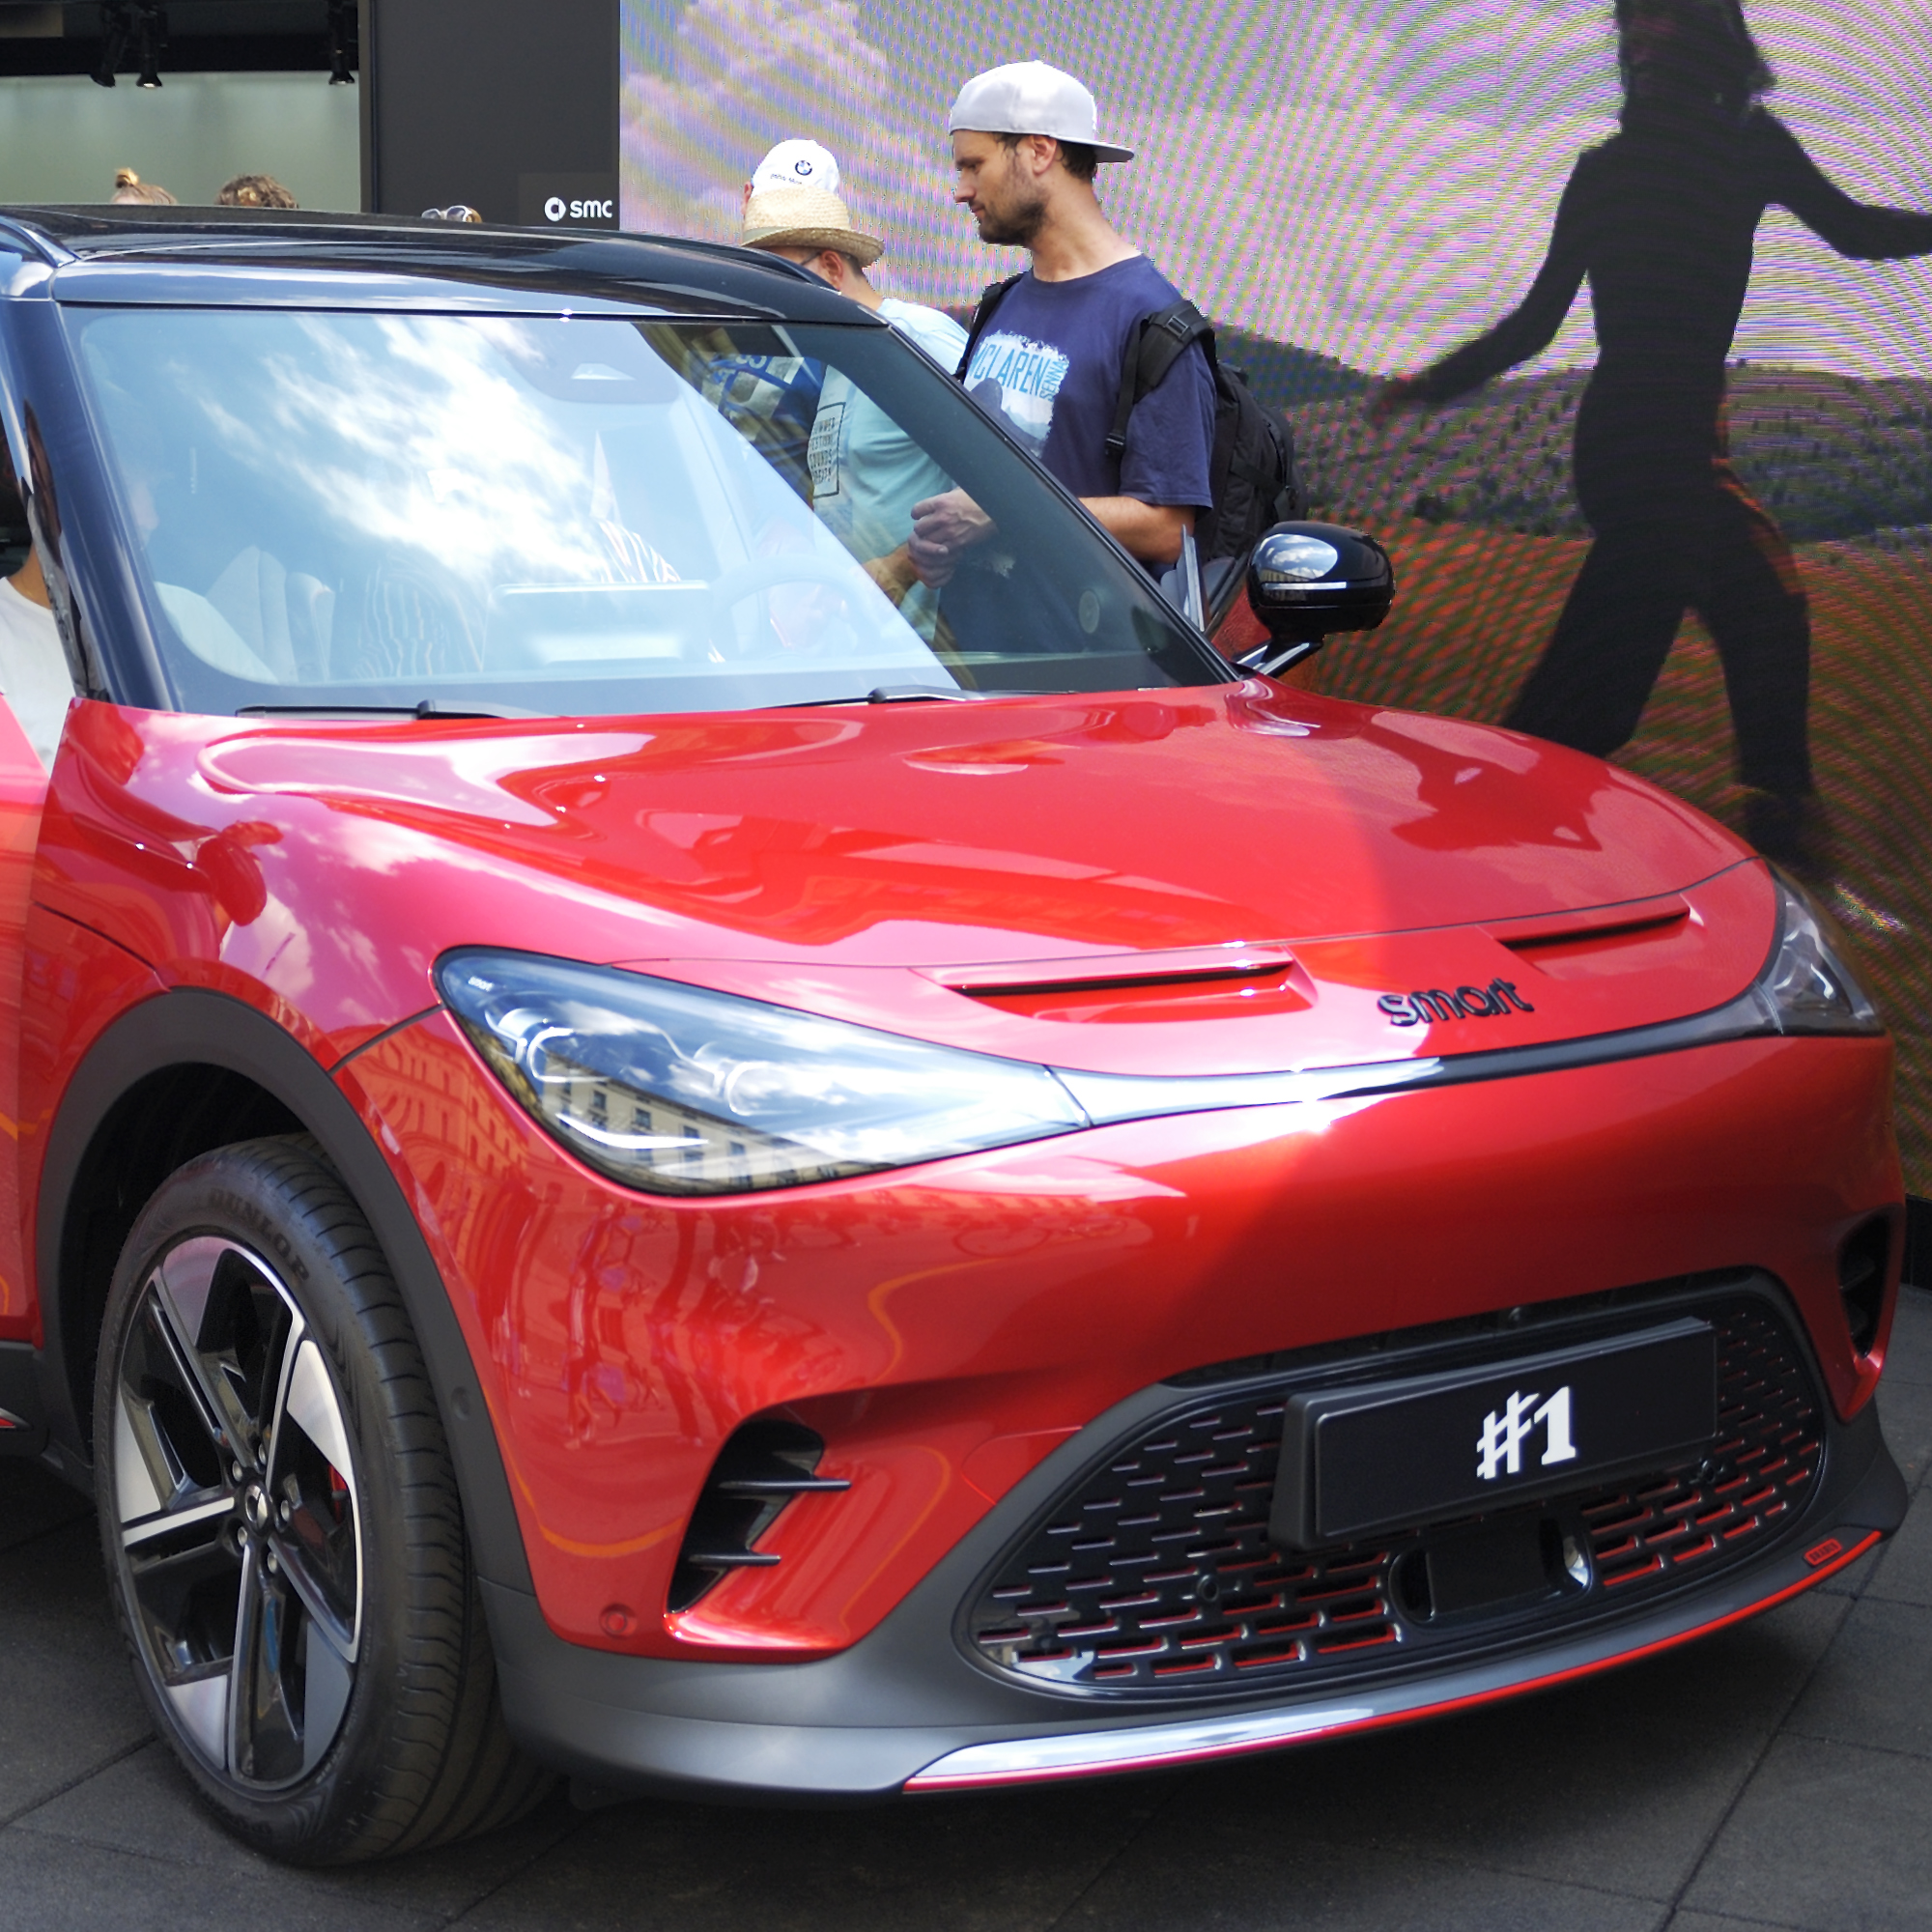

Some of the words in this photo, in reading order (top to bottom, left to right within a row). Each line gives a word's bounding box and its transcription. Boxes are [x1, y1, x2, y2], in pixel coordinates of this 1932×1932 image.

[1038, 360, 1065, 403] SENNA
[1377, 977, 1535, 1027] smart
[208, 1187, 310, 1281] DUNLOP
[1476, 1385, 1577, 1480] #1
